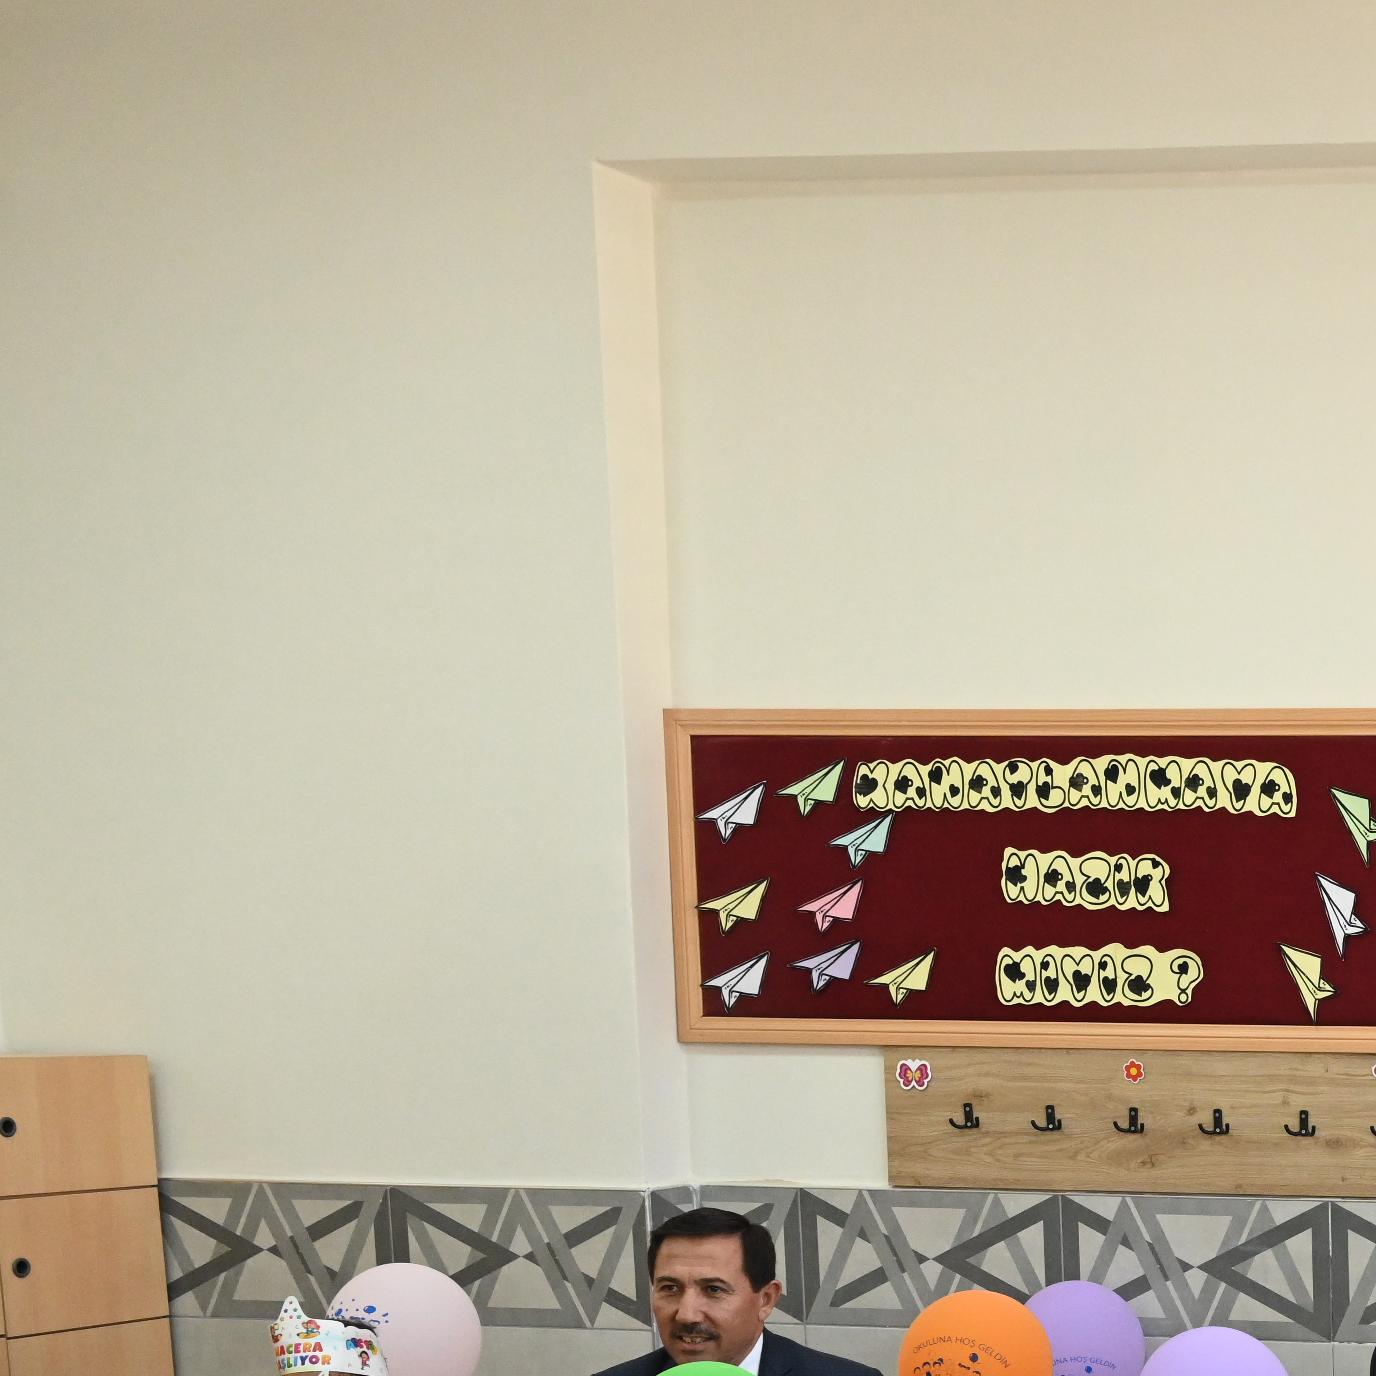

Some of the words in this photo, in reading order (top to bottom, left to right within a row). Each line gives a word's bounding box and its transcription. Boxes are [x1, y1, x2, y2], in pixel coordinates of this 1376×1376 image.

[854, 757, 1294, 816] KANATLANMAYA
[1004, 852, 1168, 908] HAZIR
[912, 1336, 952, 1354] OKULUNA
[955, 1335, 976, 1349] HOŞ
